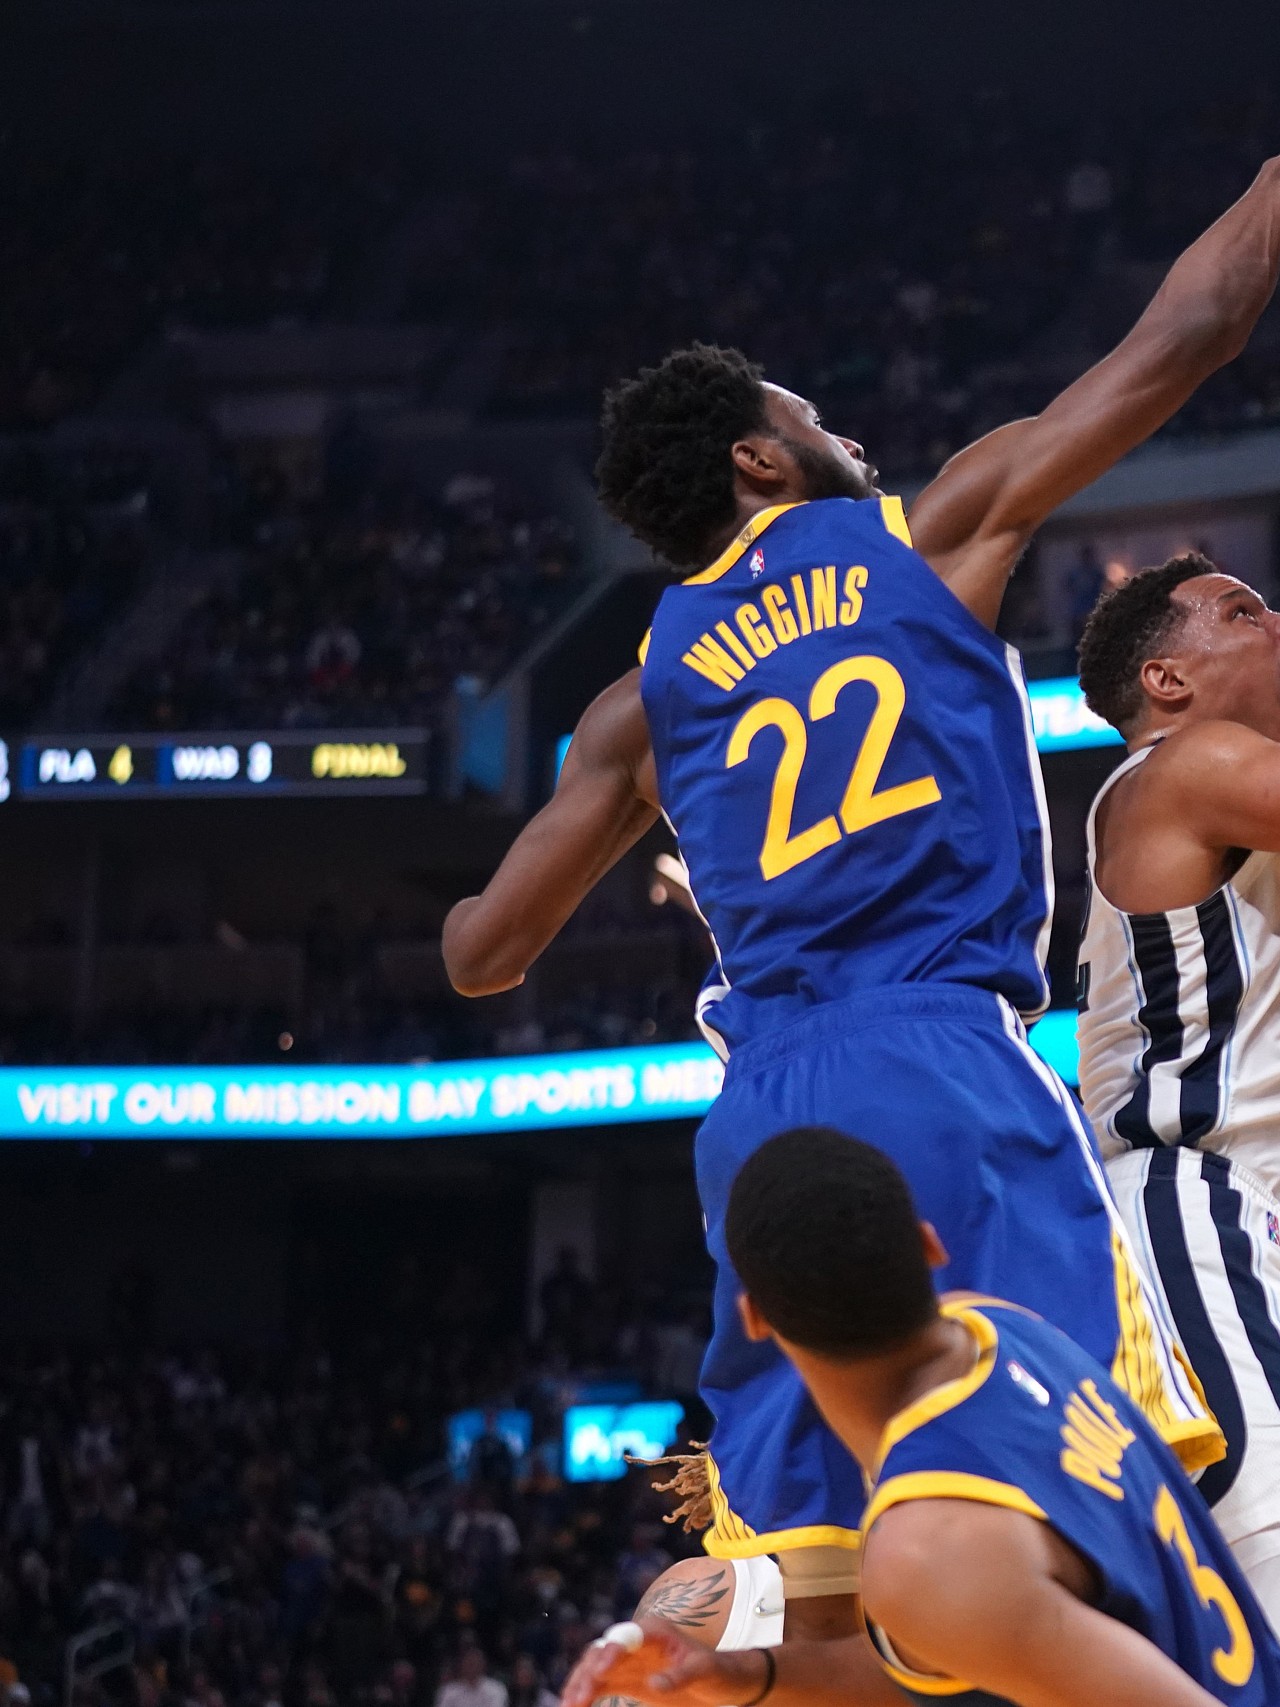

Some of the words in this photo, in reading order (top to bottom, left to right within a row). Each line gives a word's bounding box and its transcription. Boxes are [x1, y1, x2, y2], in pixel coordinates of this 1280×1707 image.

[682, 565, 869, 692] WIGGINS
[39, 748, 96, 783] FLA
[311, 742, 407, 779] FINAL
[726, 655, 942, 881] 22
[17, 1082, 118, 1126] VISIT
[123, 1081, 216, 1125] OUR
[223, 1080, 401, 1126] MISSION
[407, 1076, 487, 1123] BAY
[489, 1063, 636, 1118] SPORTS
[1060, 1378, 1136, 1500] POOLE
[1153, 1483, 1254, 1687] 3
